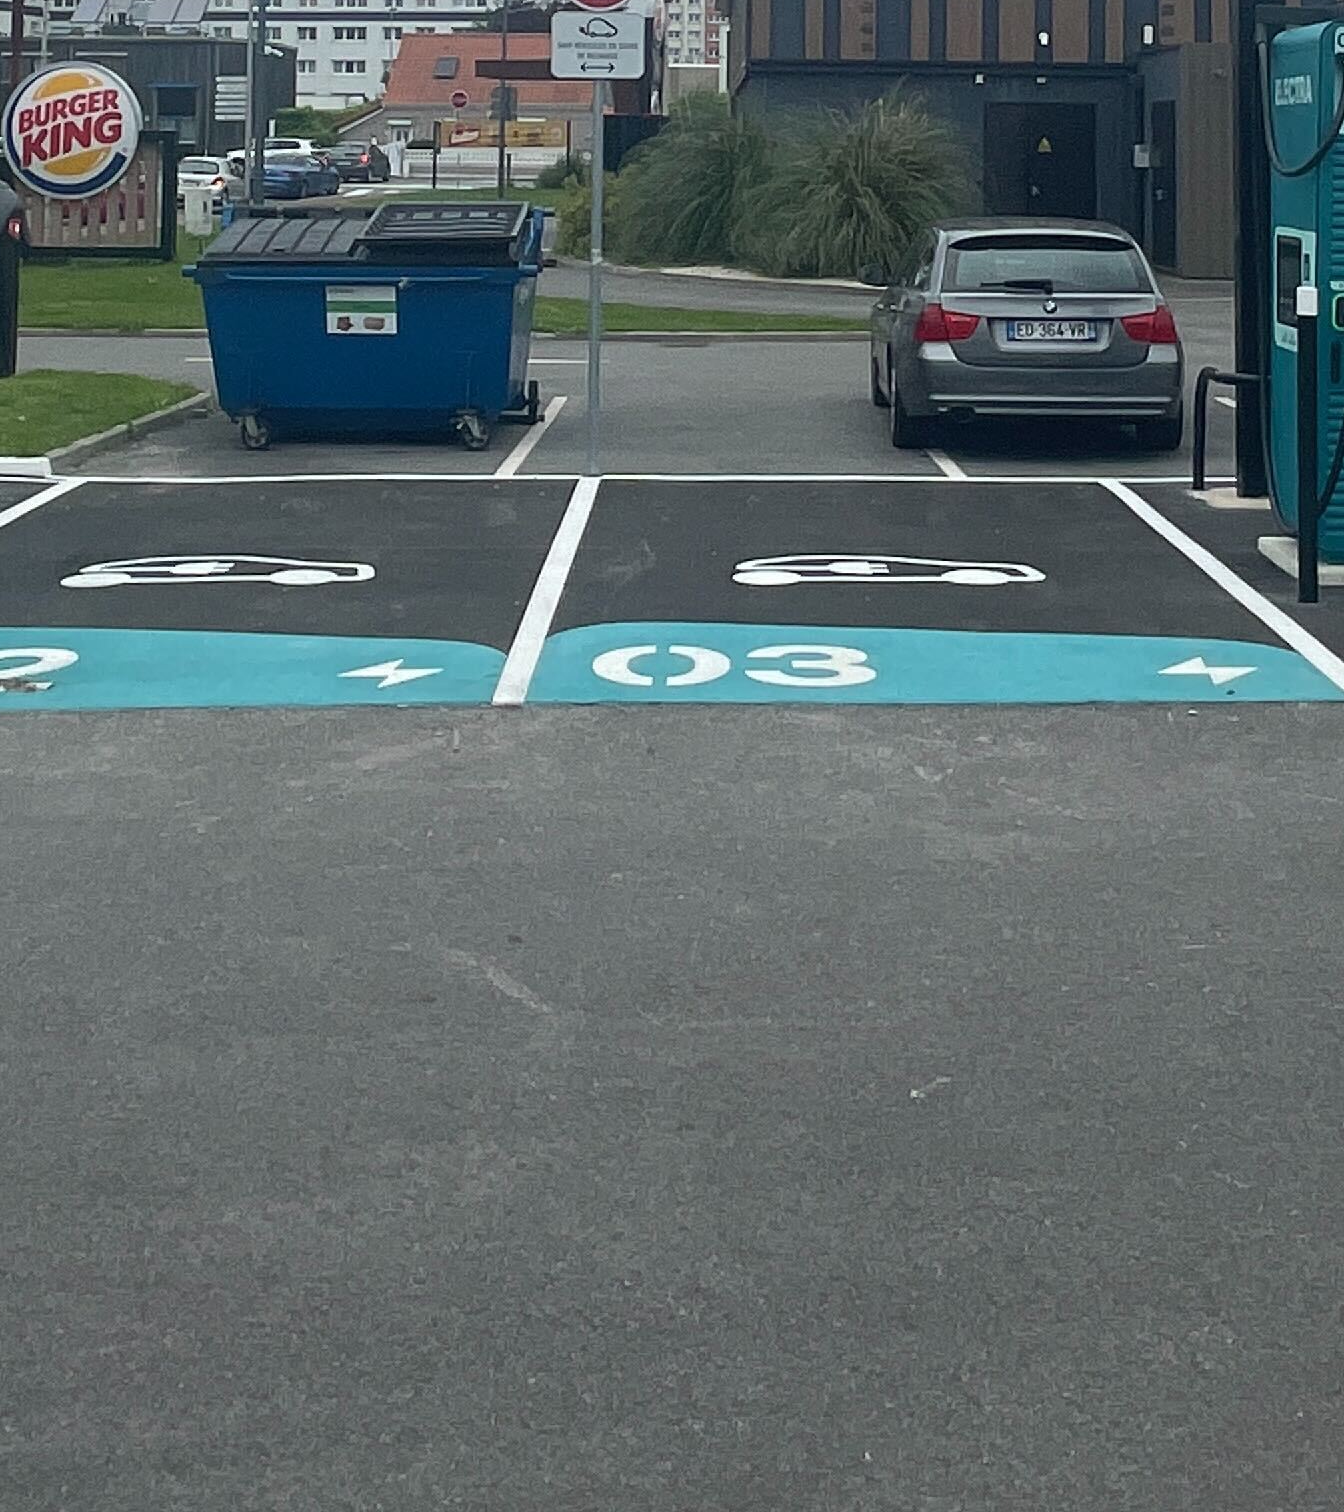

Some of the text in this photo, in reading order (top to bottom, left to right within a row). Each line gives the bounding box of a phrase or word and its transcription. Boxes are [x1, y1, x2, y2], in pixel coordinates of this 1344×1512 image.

[18, 89, 120, 135] BURGER
[22, 112, 122, 168] KING
[592, 644, 877, 688] 03
